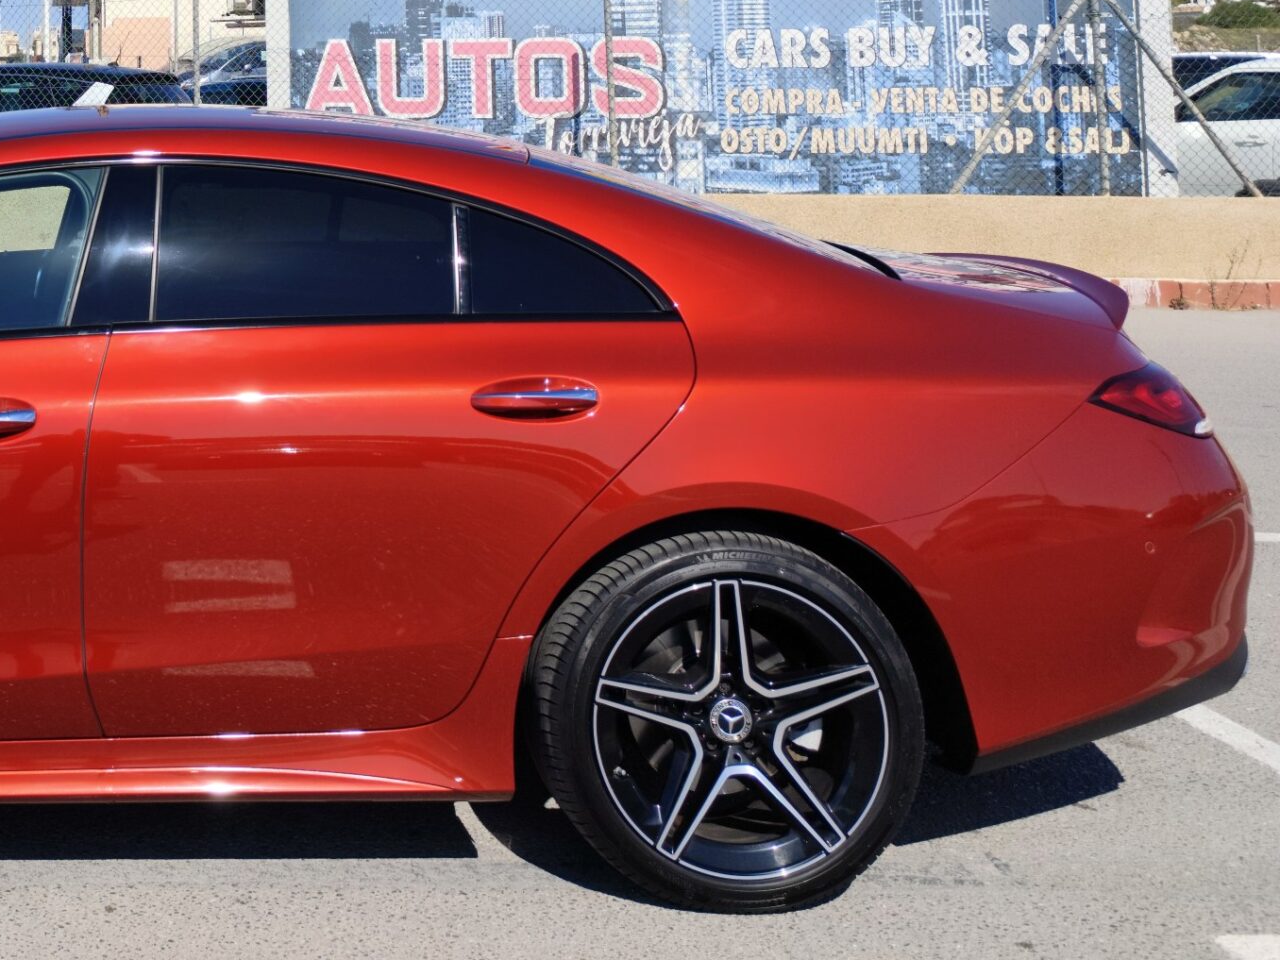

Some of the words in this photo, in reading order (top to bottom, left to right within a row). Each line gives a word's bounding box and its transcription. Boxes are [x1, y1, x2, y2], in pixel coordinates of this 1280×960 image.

[725, 26, 831, 69] CARS
[848, 26, 936, 68] BUY
[955, 24, 990, 67] &
[304, 37, 665, 119] AUTOS
[725, 88, 845, 114] COMPRA
[871, 87, 959, 114] VENTA
[970, 87, 1005, 113] DE
